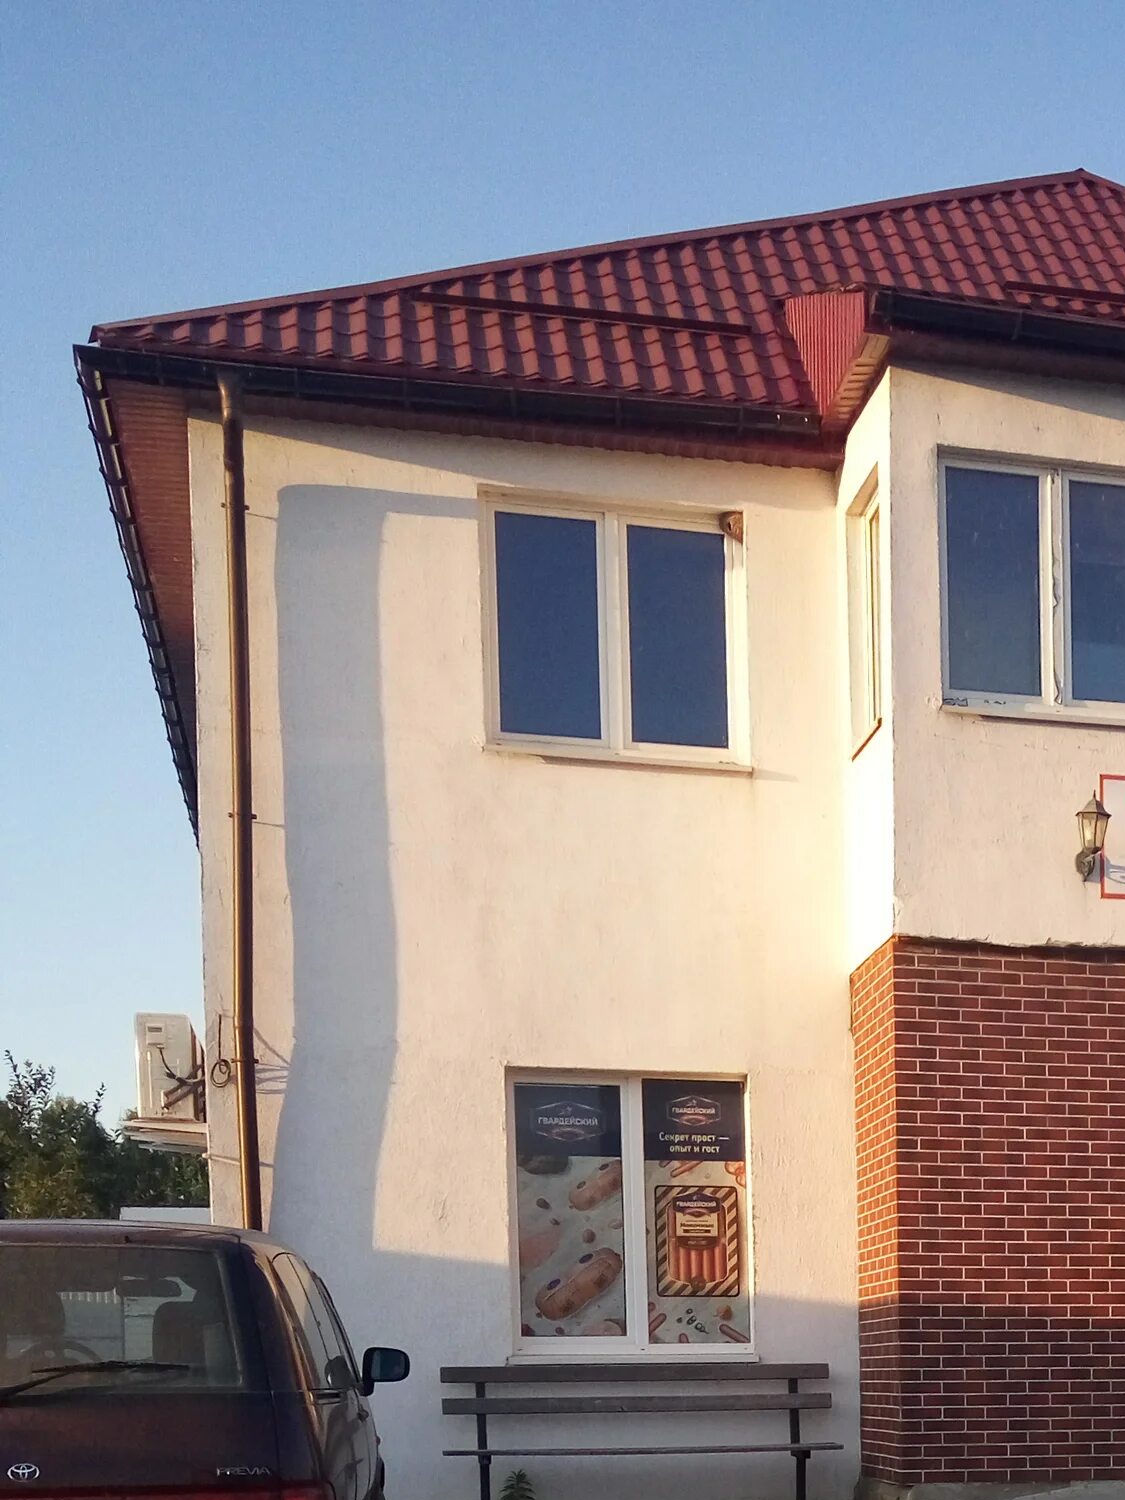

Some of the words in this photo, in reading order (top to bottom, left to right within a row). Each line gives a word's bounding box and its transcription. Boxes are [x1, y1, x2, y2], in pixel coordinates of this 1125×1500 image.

[538, 1116, 598, 1126] ГВАРДЕЙСКИЙ
[659, 1132, 689, 1143] Секрет
[692, 1134, 716, 1143] прост
[669, 1145, 691, 1153] опыт
[216, 1467, 271, 1476] PREVIA
